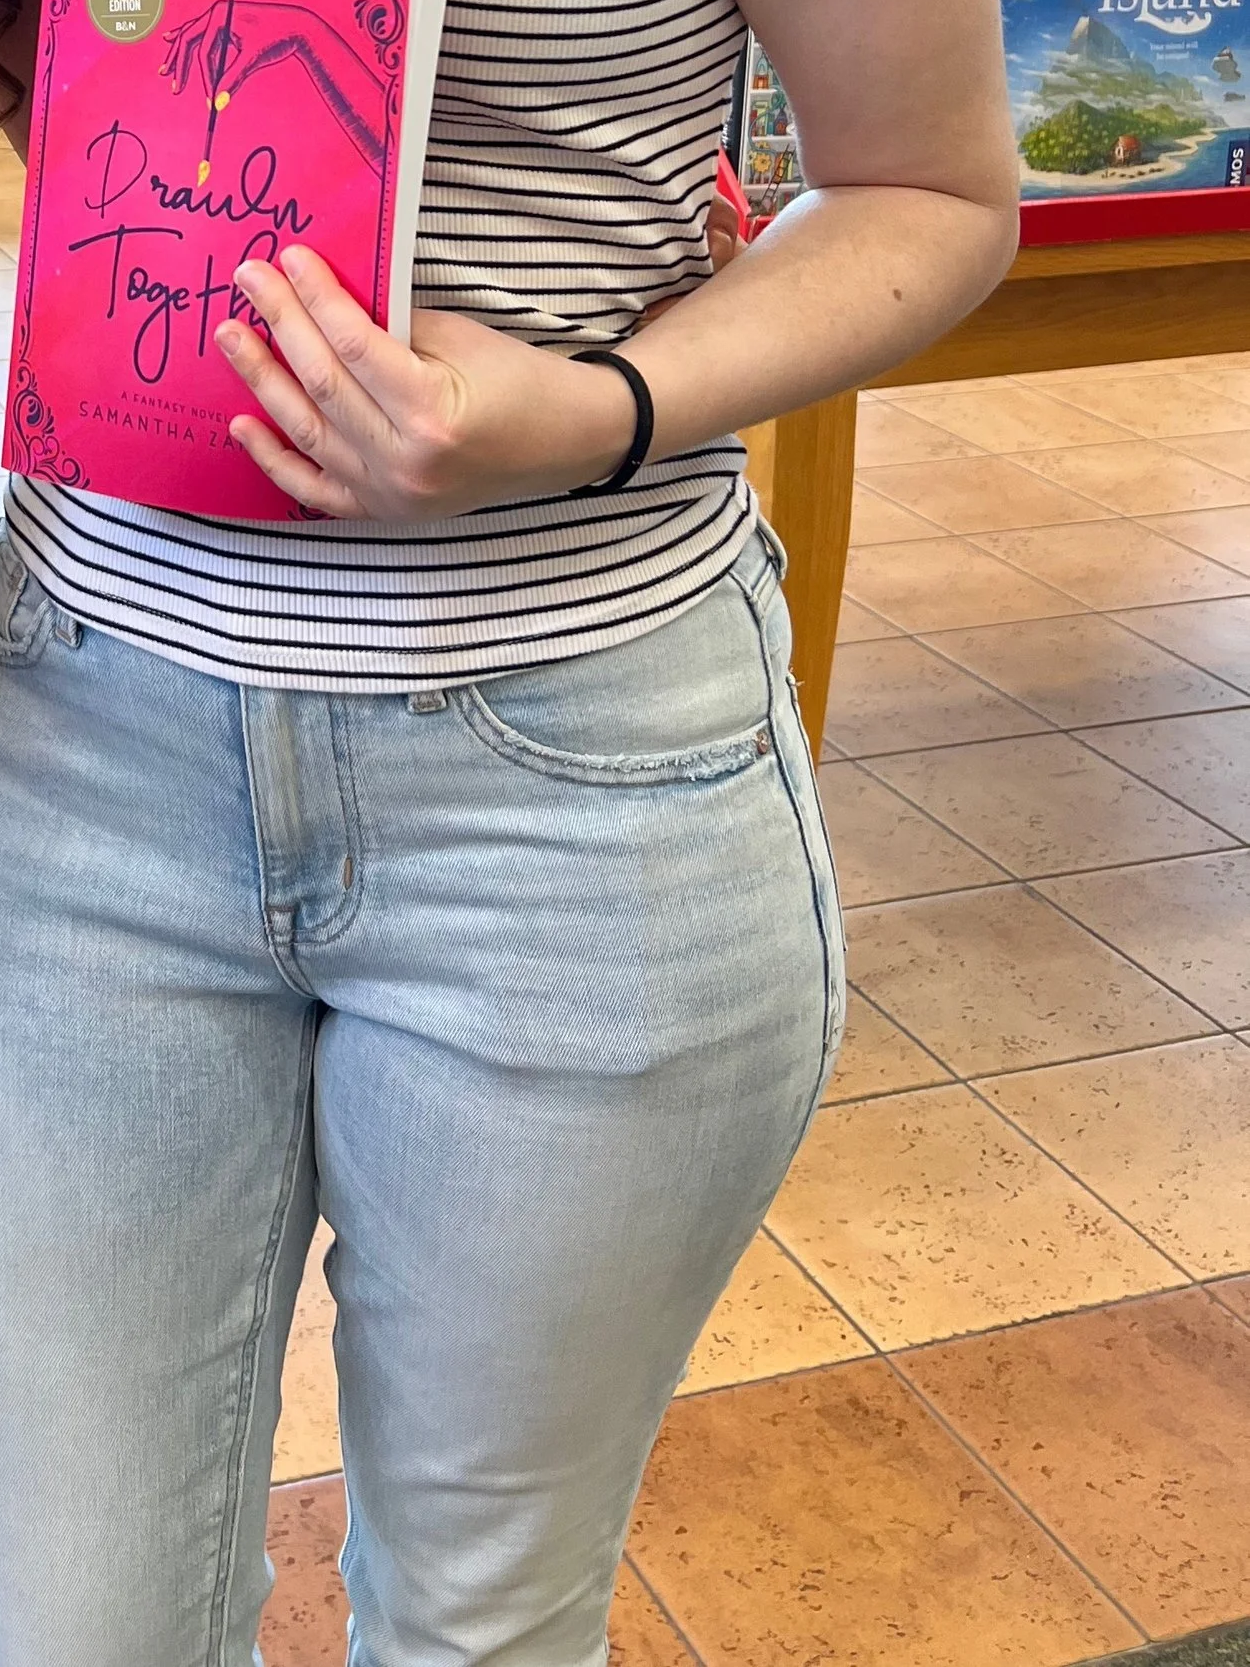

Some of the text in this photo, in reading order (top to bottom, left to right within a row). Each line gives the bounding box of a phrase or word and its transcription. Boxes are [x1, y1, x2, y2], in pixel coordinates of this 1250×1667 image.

[109, 0, 142, 12] EDITION
[115, 21, 137, 31] B&N
[84, 119, 313, 234] Drawn
[1230, 147, 1245, 186] MOS
[68, 224, 278, 384] Togeth
[79, 401, 196, 444] SAMANTHA
[121, 391, 230, 425] A FANTASY NOVEL
